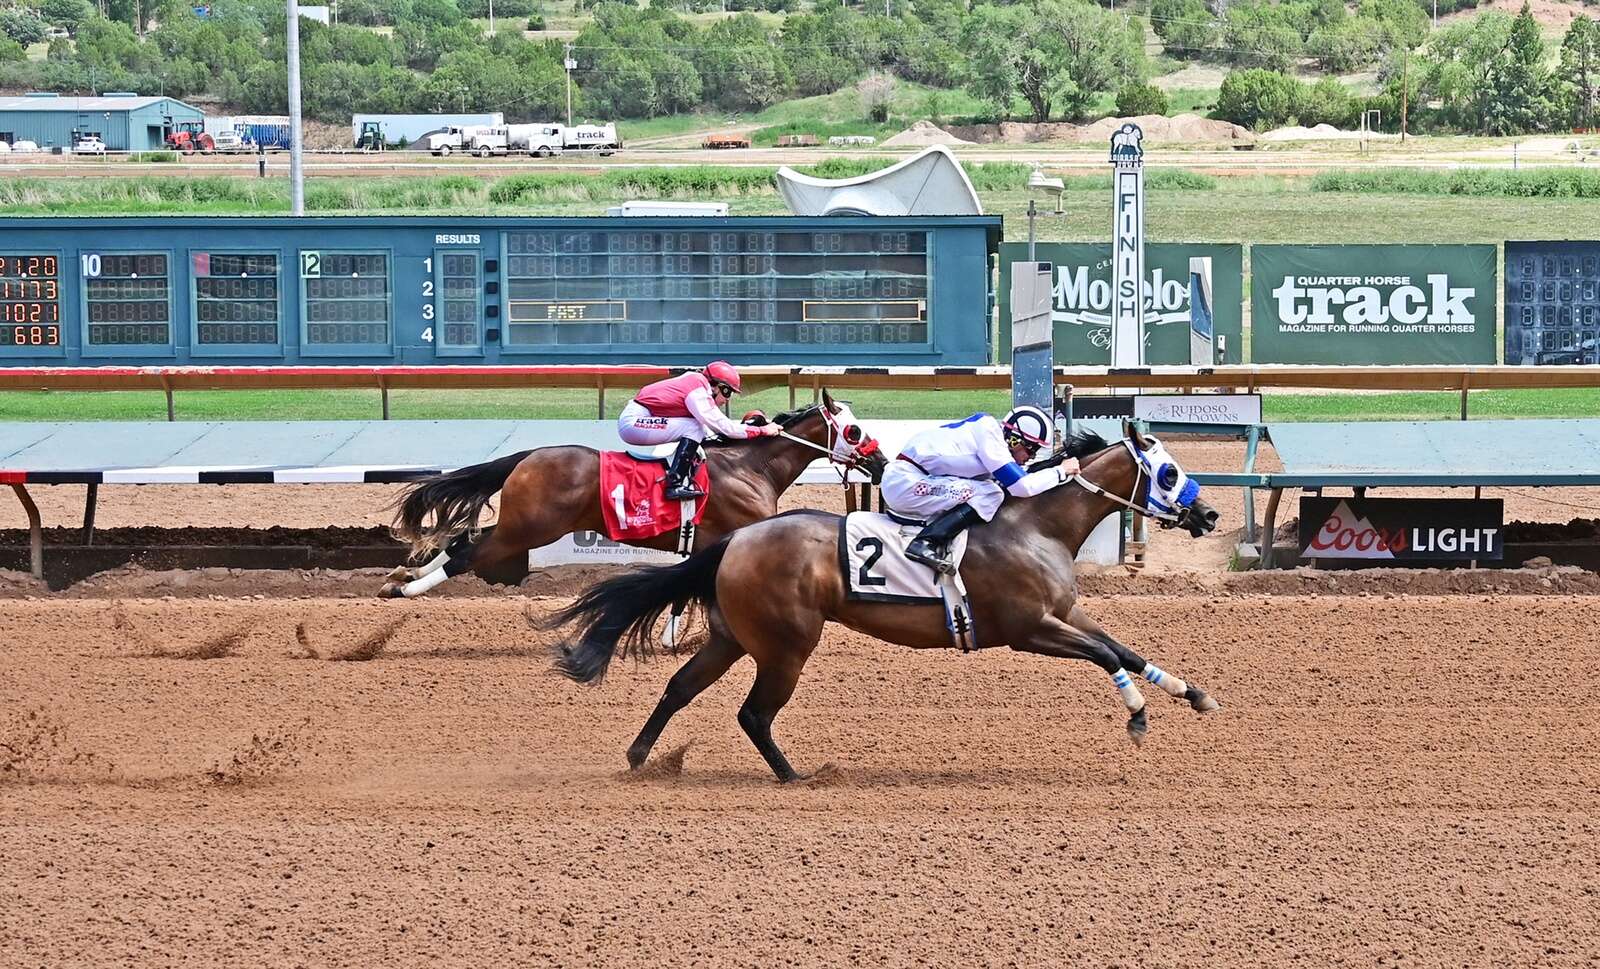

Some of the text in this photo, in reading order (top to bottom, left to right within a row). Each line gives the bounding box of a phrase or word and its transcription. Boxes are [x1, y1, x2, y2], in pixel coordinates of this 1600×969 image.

[577, 131, 605, 139] track
[436, 234, 481, 244] RESULTS
[1119, 193, 1136, 318] FINISH
[81, 254, 101, 276] 10
[301, 253, 320, 276] 12
[423, 257, 432, 273] 1
[4, 281, 57, 299] 1173
[422, 281, 434, 296] 2
[1297, 277, 1411, 286] QUARTER HORSE
[1272, 274, 1476, 325] track
[6, 304, 58, 322] 1021
[422, 304, 434, 320] 3
[547, 305, 587, 319] FAST
[15, 326, 58, 345] 683
[421, 327, 434, 342] 4
[1279, 324, 1475, 333] MAGAZINE FOR RUNNING QUARTER HORSES
[1171, 405, 1228, 417] RUIDOSO
[611, 484, 628, 529] 1
[1312, 515, 1498, 552] Coors LIGHT
[856, 537, 886, 585] 2
